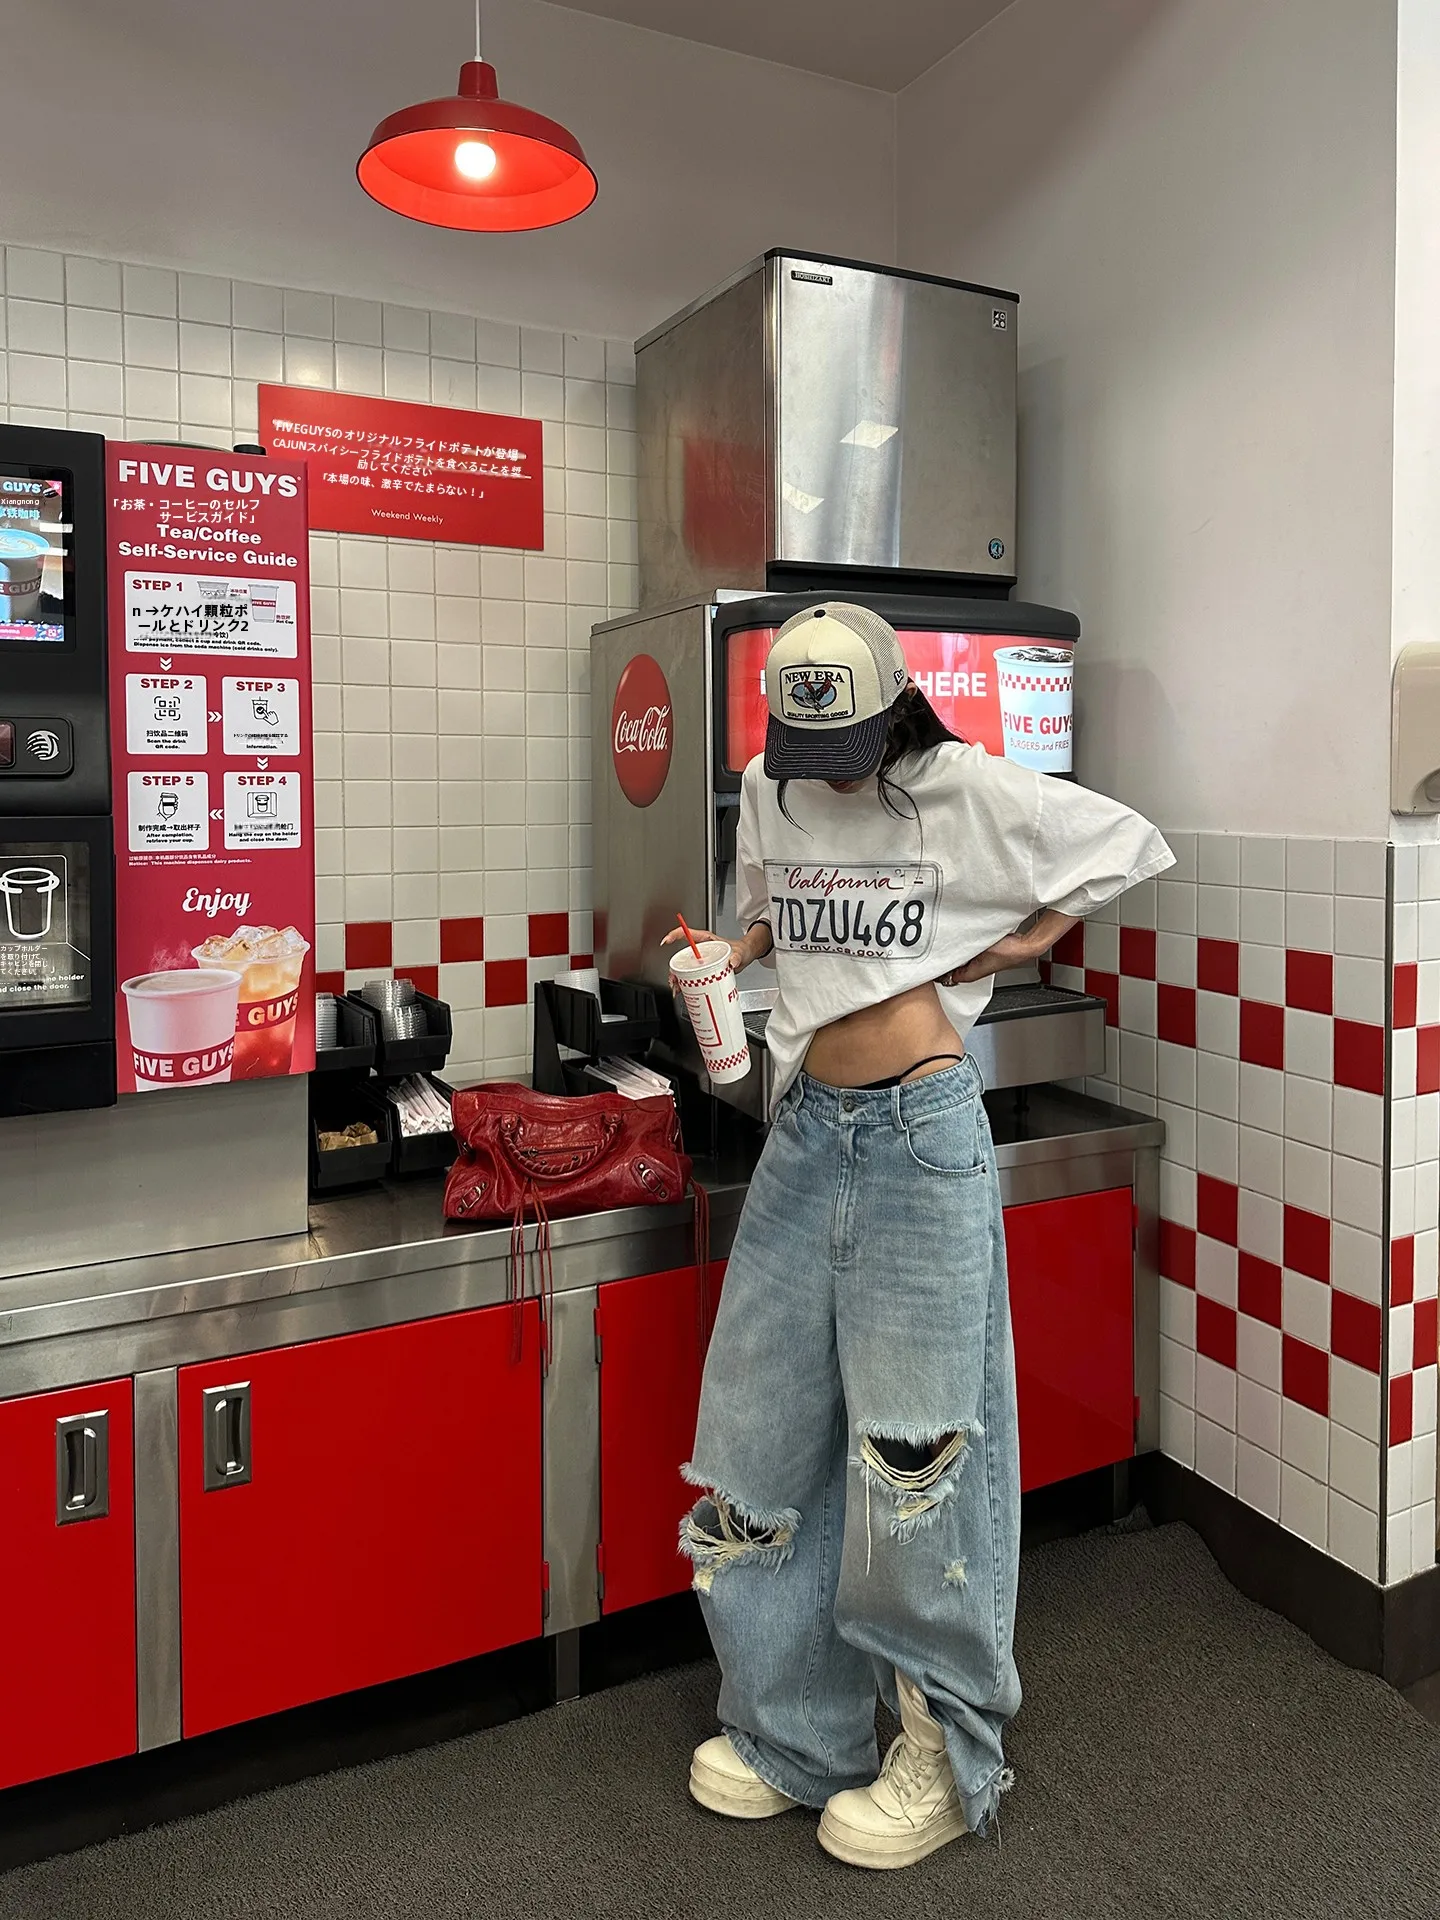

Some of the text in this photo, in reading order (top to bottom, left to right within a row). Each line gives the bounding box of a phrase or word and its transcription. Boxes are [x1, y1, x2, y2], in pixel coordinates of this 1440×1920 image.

[2, 481, 41, 494] GUYS
[118, 460, 298, 498] FIVE GUYS
[371, 509, 444, 525] Weekend Weekly
[156, 523, 262, 545] Tea/Coffee
[118, 541, 298, 568] Self-Service Guide
[132, 579, 183, 592] STEP 1
[140, 678, 193, 690] STEP 2
[236, 681, 286, 692] STEP 3
[785, 671, 845, 684] NEW ERA
[915, 671, 987, 697] HERE
[1004, 711, 1033, 734] FIVE
[1010, 737, 1070, 751] BURGERS and FRIES
[142, 776, 194, 786] STEP 5
[237, 776, 287, 786] STEP 4
[788, 867, 904, 897] California
[182, 887, 252, 918] Enjoy
[771, 896, 925, 948] 7DZU468
[247, 992, 299, 1026] GUYS
[133, 1041, 234, 1078] FIVE GUYS
